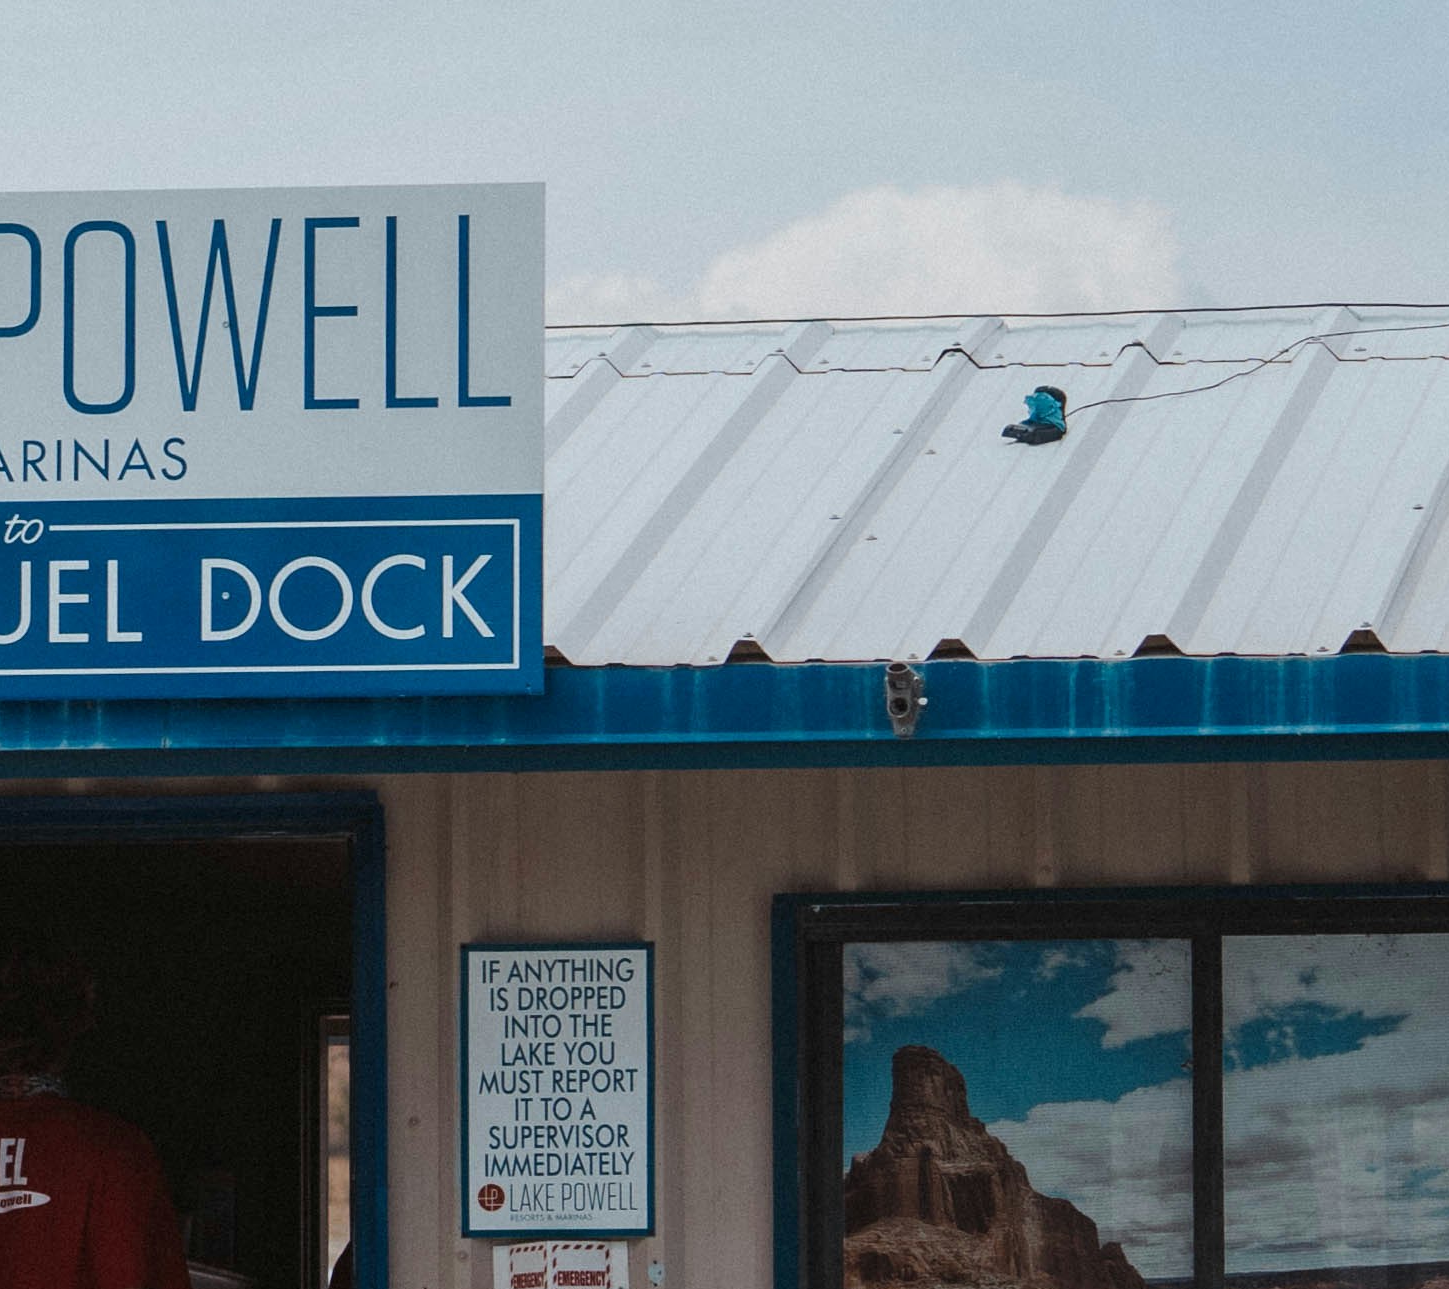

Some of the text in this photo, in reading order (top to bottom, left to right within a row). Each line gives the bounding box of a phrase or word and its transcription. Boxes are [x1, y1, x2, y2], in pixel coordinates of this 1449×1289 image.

[3, 513, 45, 544] to
[201, 554, 493, 642] DOCK
[482, 958, 634, 984] IF ANYTHING
[490, 986, 626, 1012] IS DROPPED
[505, 1014, 612, 1038] INTO THE
[501, 1041, 615, 1066] LAKE YOU
[479, 1068, 638, 1094] MUST REPORT
[515, 1097, 596, 1121] IT TO A
[489, 1124, 629, 1150] SUPERVISOR
[485, 1152, 634, 1177] IMMEDIATELY
[510, 1182, 639, 1212] LAKE POWELL
[512, 1272, 545, 1289] EMERGENCY
[558, 1271, 606, 1286] EMERGENCY
